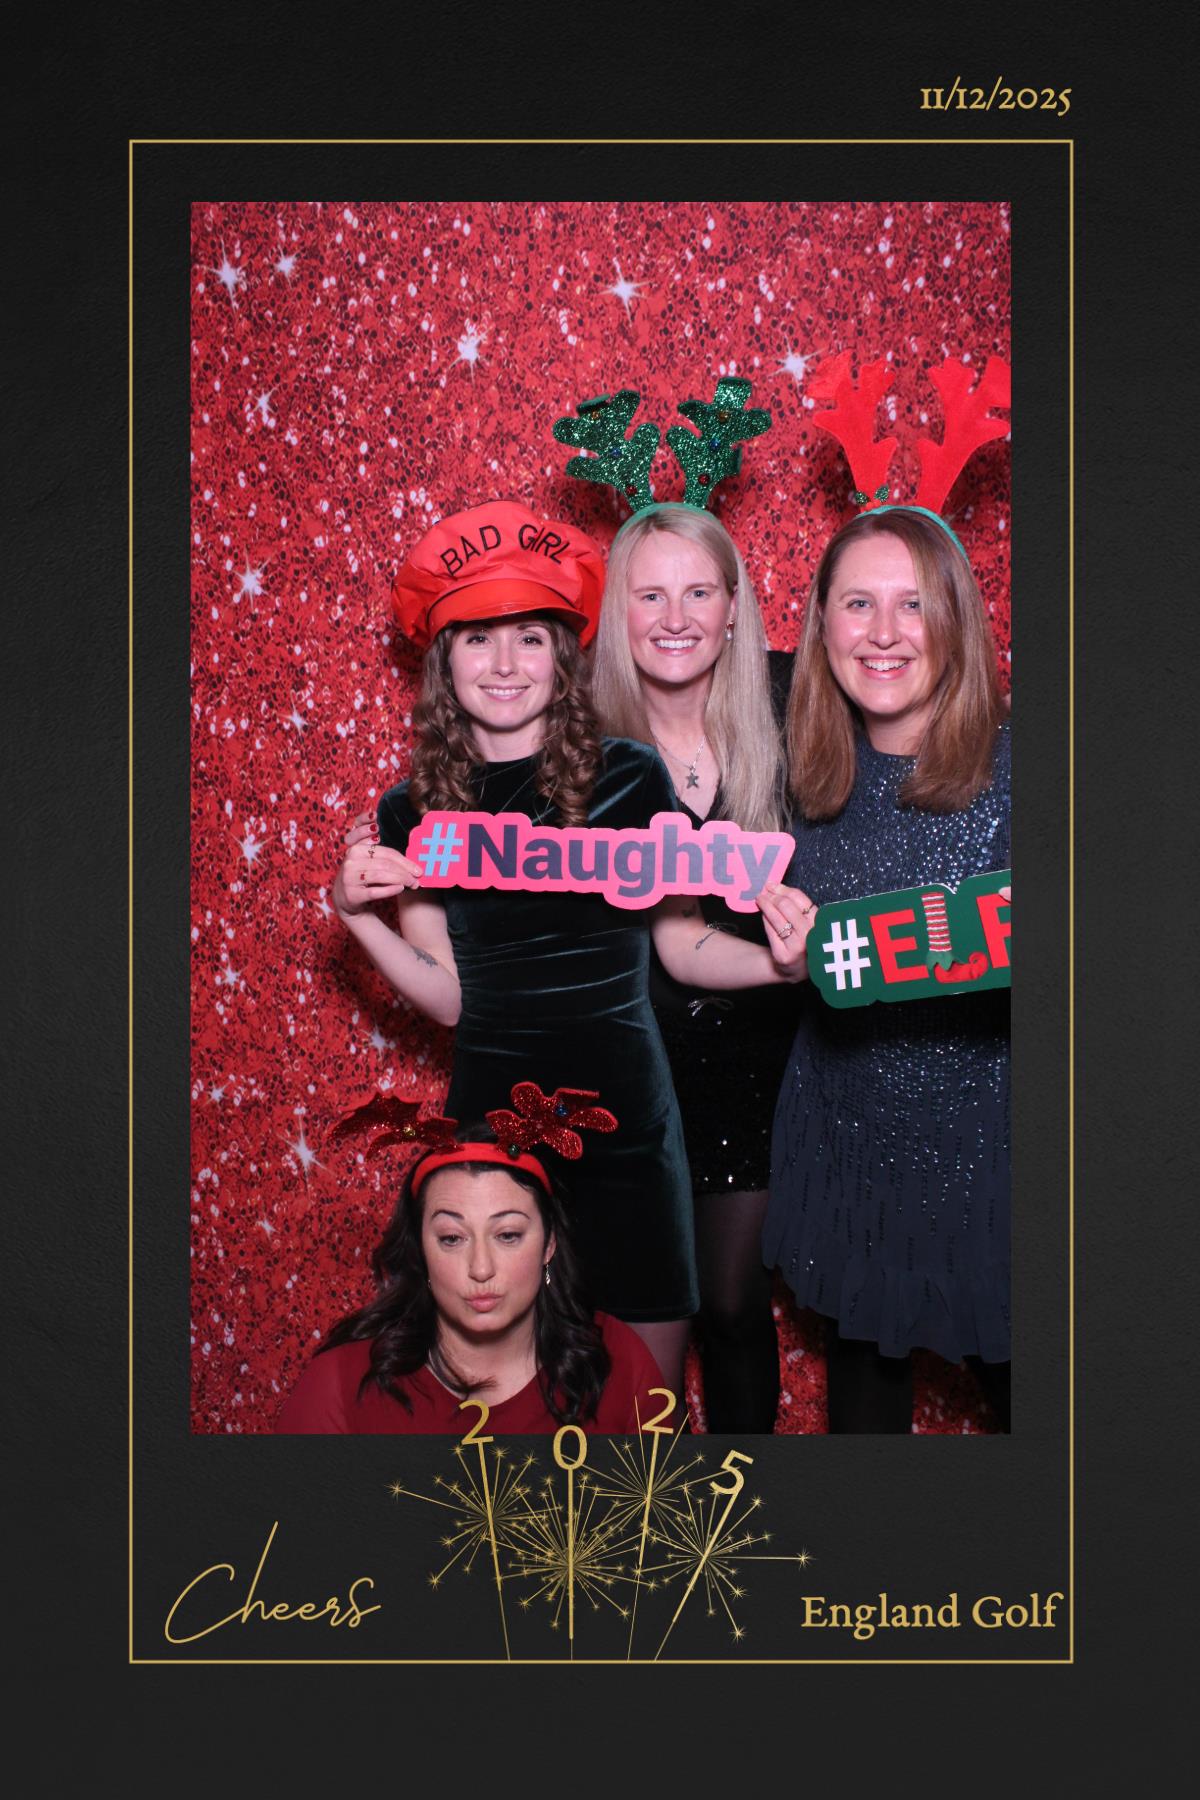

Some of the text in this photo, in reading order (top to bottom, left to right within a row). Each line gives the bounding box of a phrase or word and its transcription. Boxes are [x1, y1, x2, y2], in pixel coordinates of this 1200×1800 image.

[440, 523, 570, 577] BAD GIRL
[418, 822, 780, 901] #Naughty
